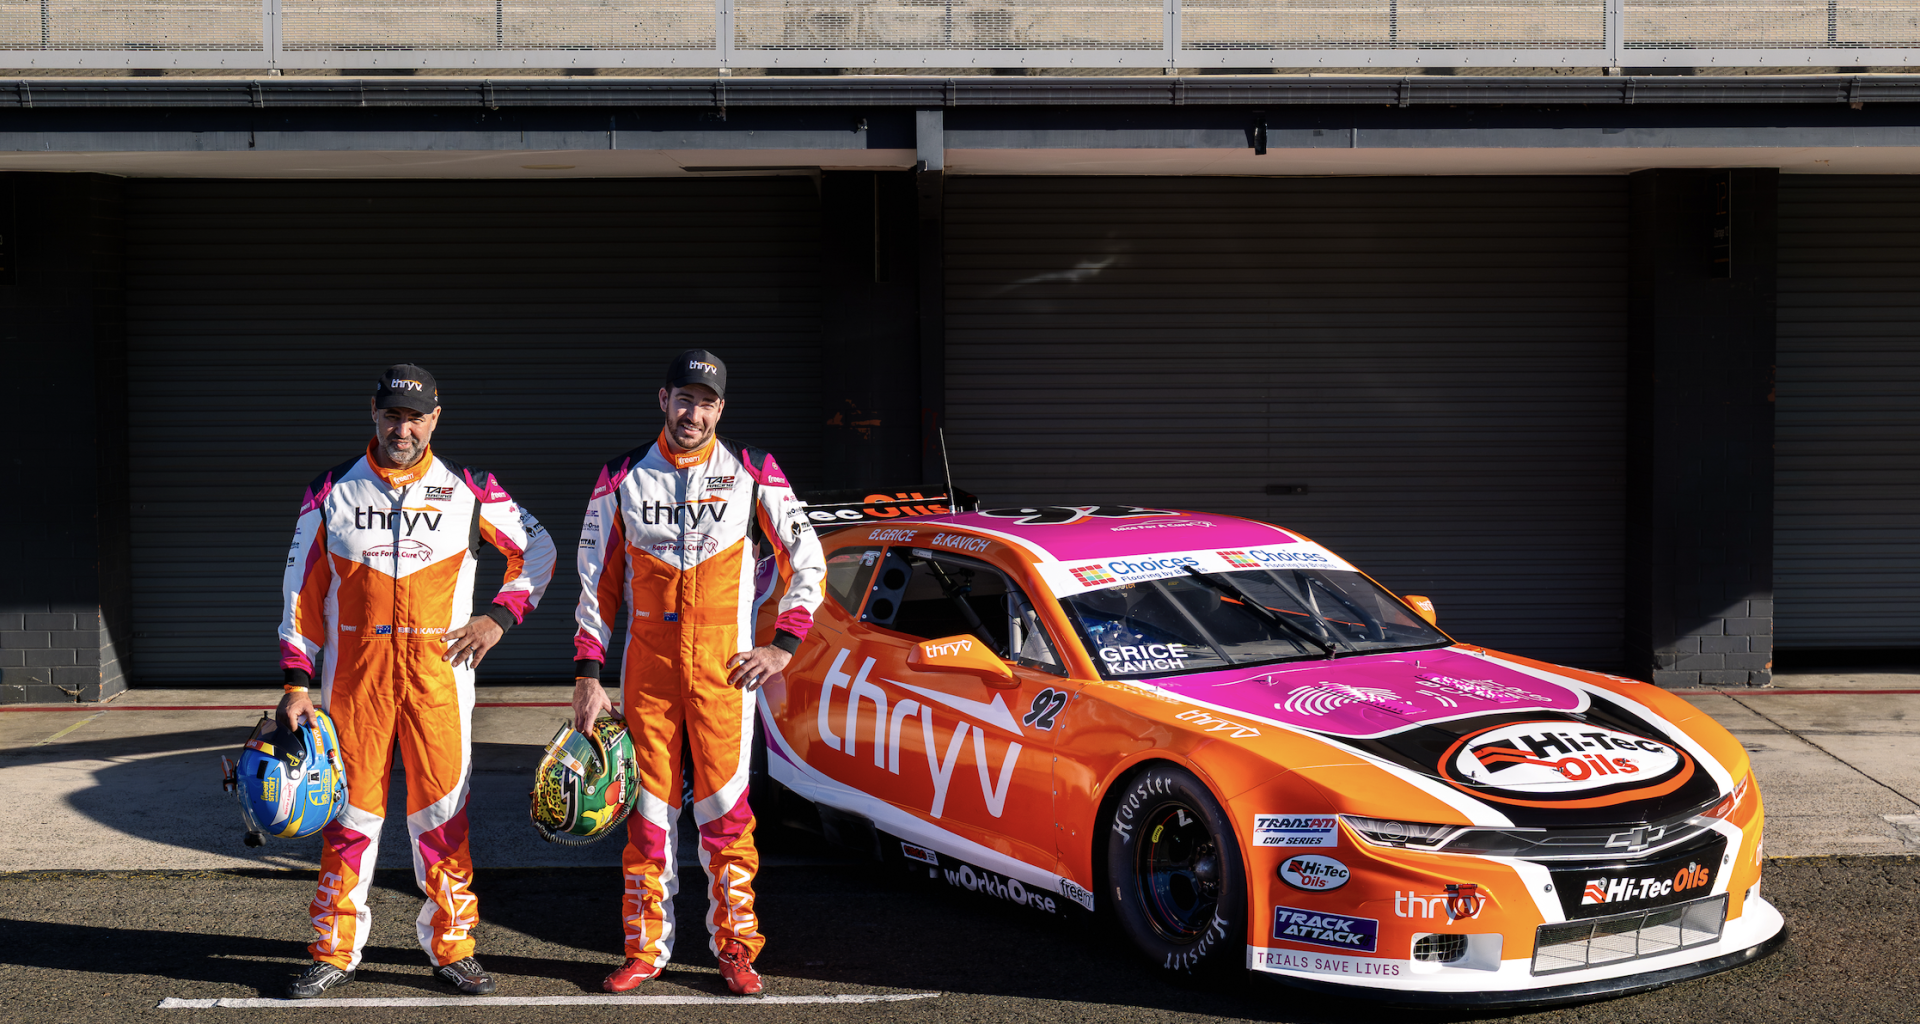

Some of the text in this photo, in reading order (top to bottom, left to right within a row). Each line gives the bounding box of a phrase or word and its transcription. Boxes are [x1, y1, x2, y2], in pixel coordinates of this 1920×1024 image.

[1715, 181, 1727, 216] 12
[689, 360, 717, 375] thryv
[391, 378, 423, 391] thryv
[679, 456, 700, 464] freem
[393, 472, 415, 484] freem
[705, 475, 735, 485] TA2
[424, 485, 454, 494] TA2
[355, 505, 443, 537] thryv
[643, 500, 728, 530] thryv
[687, 543, 703, 551] Cure
[868, 528, 991, 552] B.GRICE B.KAVICH
[401, 551, 418, 559] Cure
[1249, 549, 1327, 562] Choices
[1108, 556, 1200, 576] Choices
[1121, 572, 1162, 583] Flooring
[926, 641, 972, 659] thryv
[1099, 643, 1188, 662] GRICE
[1107, 658, 1184, 675] KAVICH
[1023, 687, 1068, 731] 92
[818, 647, 1023, 819] thryv
[1175, 710, 1259, 738] thryv
[1519, 732, 1664, 769] Hi-Tec
[1560, 753, 1640, 781] Oils
[1113, 773, 1172, 845] Hoosier
[1263, 837, 1324, 845] CUP SERIES
[1302, 861, 1348, 878] Hi-Tec
[944, 864, 1057, 914] workhOrse
[1301, 875, 1327, 888] Oils
[1605, 864, 1709, 903] Hi-Tec Oils
[1060, 877, 1093, 909] freem
[1394, 890, 1487, 926] thryv
[1278, 911, 1354, 931] TRACK
[1283, 925, 1364, 945] ATTACK
[1258, 953, 1400, 976] TRIALS SAVE LIVES
